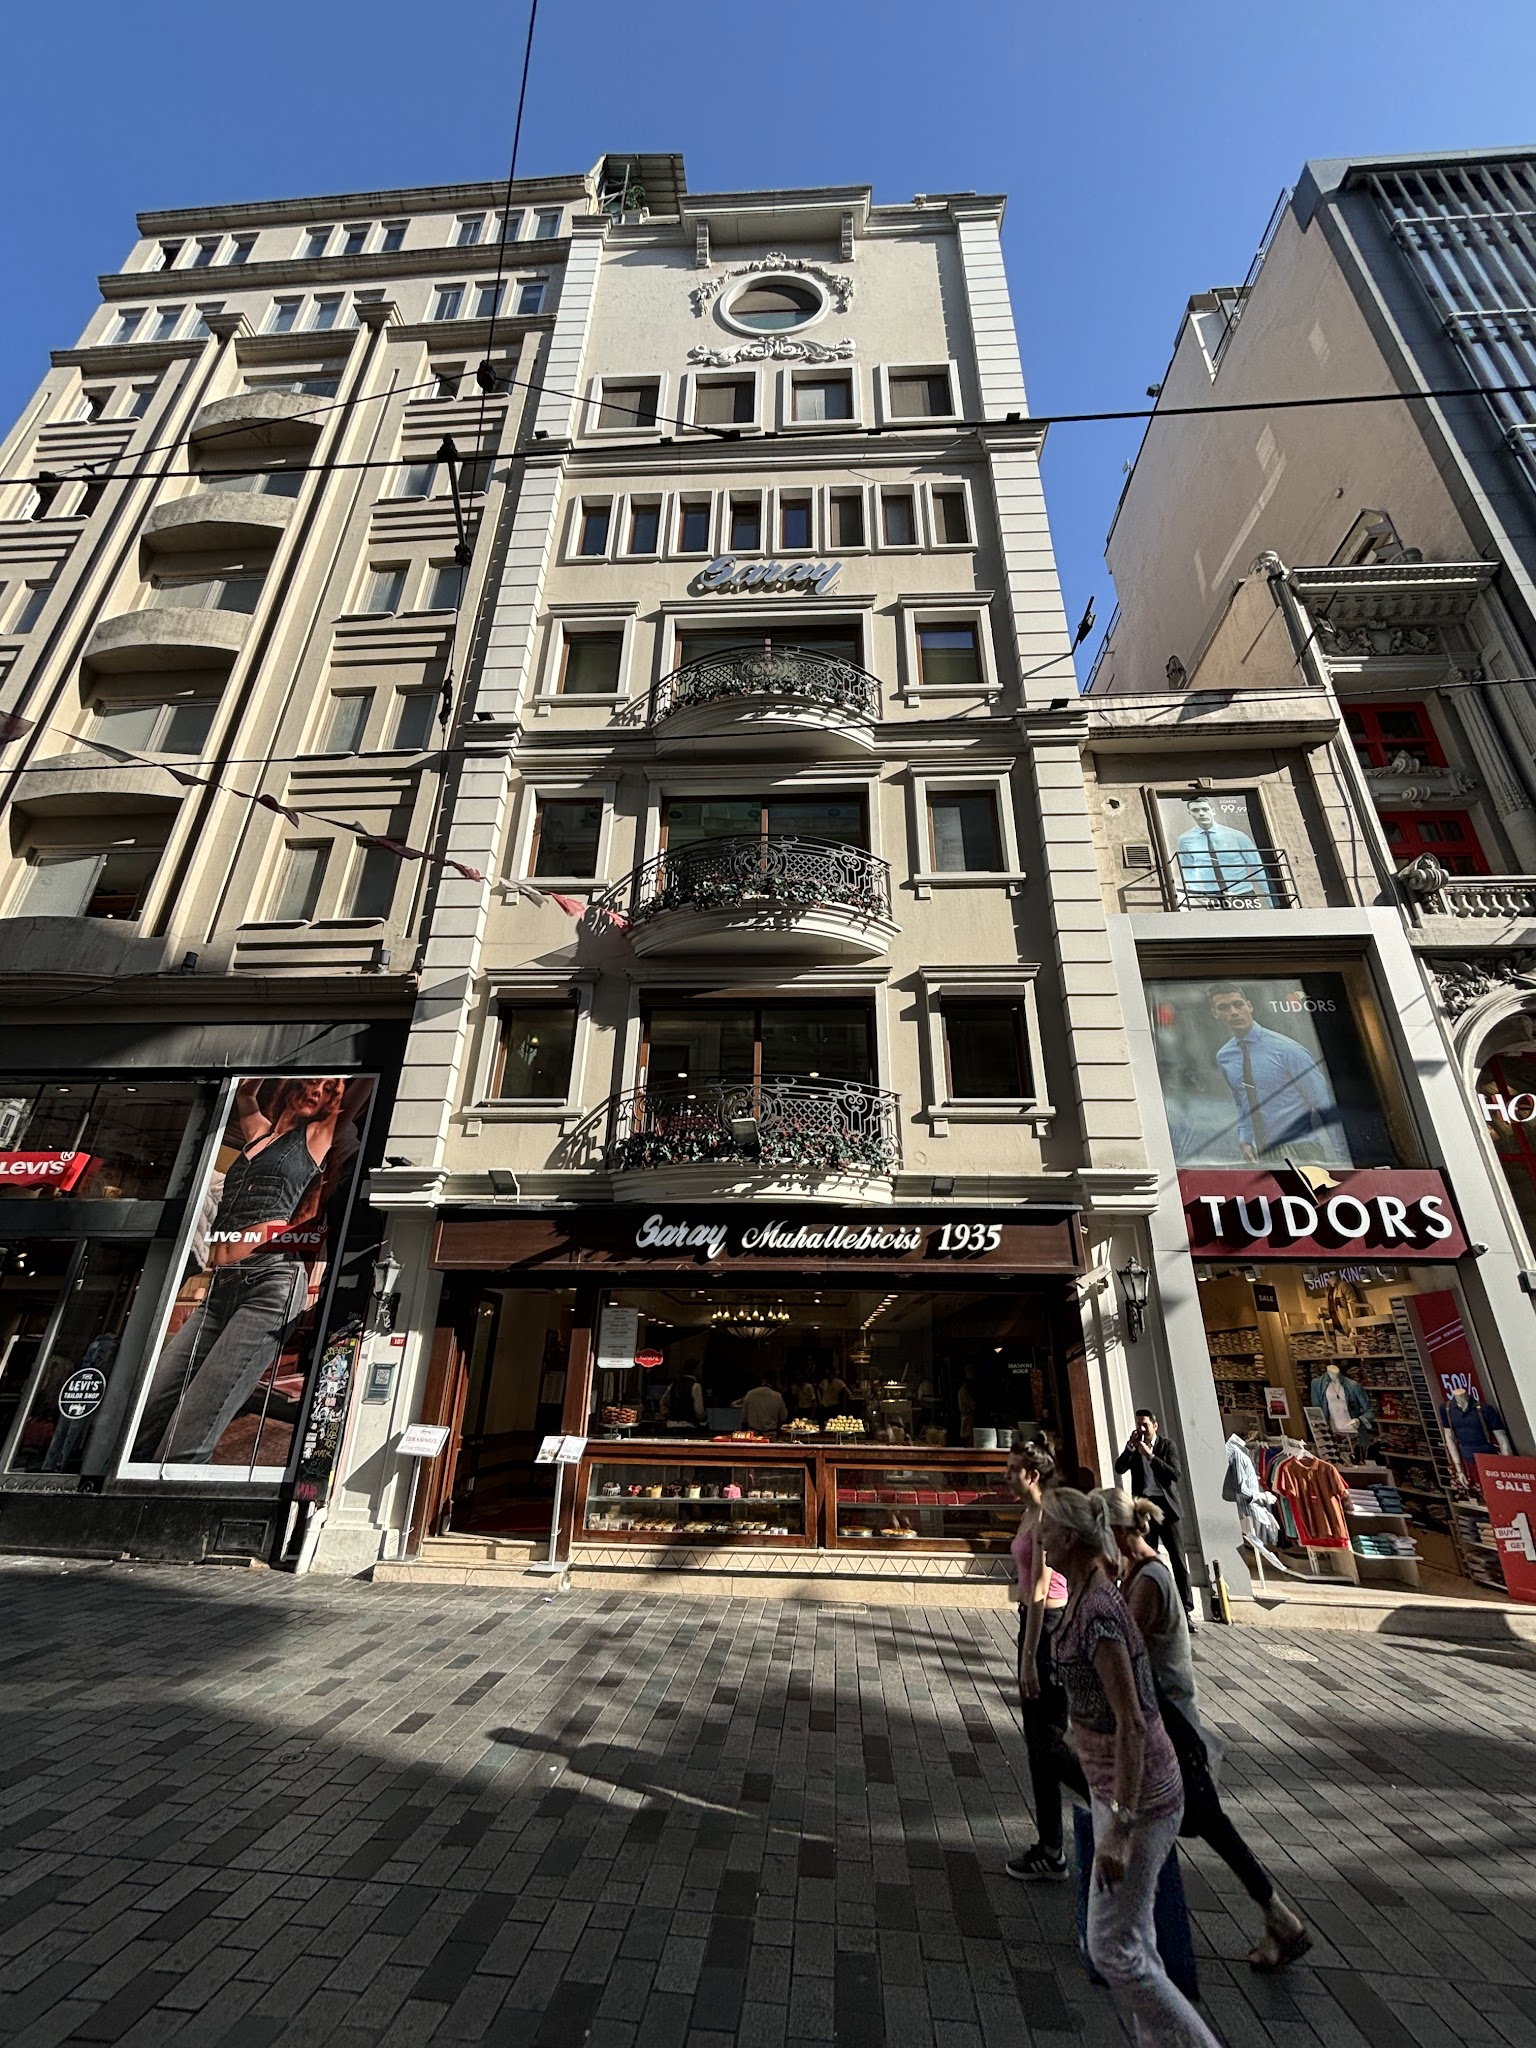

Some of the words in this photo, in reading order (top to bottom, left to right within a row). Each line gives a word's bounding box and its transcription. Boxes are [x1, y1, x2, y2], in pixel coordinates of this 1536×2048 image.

[699, 555, 843, 595] Saray
[1269, 1000, 1336, 1013] TUDORS
[1200, 1195, 1452, 1239] TUDORS
[243, 1232, 262, 1242] IN
[636, 1214, 728, 1259] Saray
[741, 1220, 922, 1250] Muhallebicisi
[937, 1223, 1003, 1251] 1935
[68, 1380, 100, 1391] LEVI'S
[1485, 1469, 1500, 1478] BIG
[1500, 1471, 1536, 1480] SUMMER
[1495, 1480, 1532, 1493] SALE
